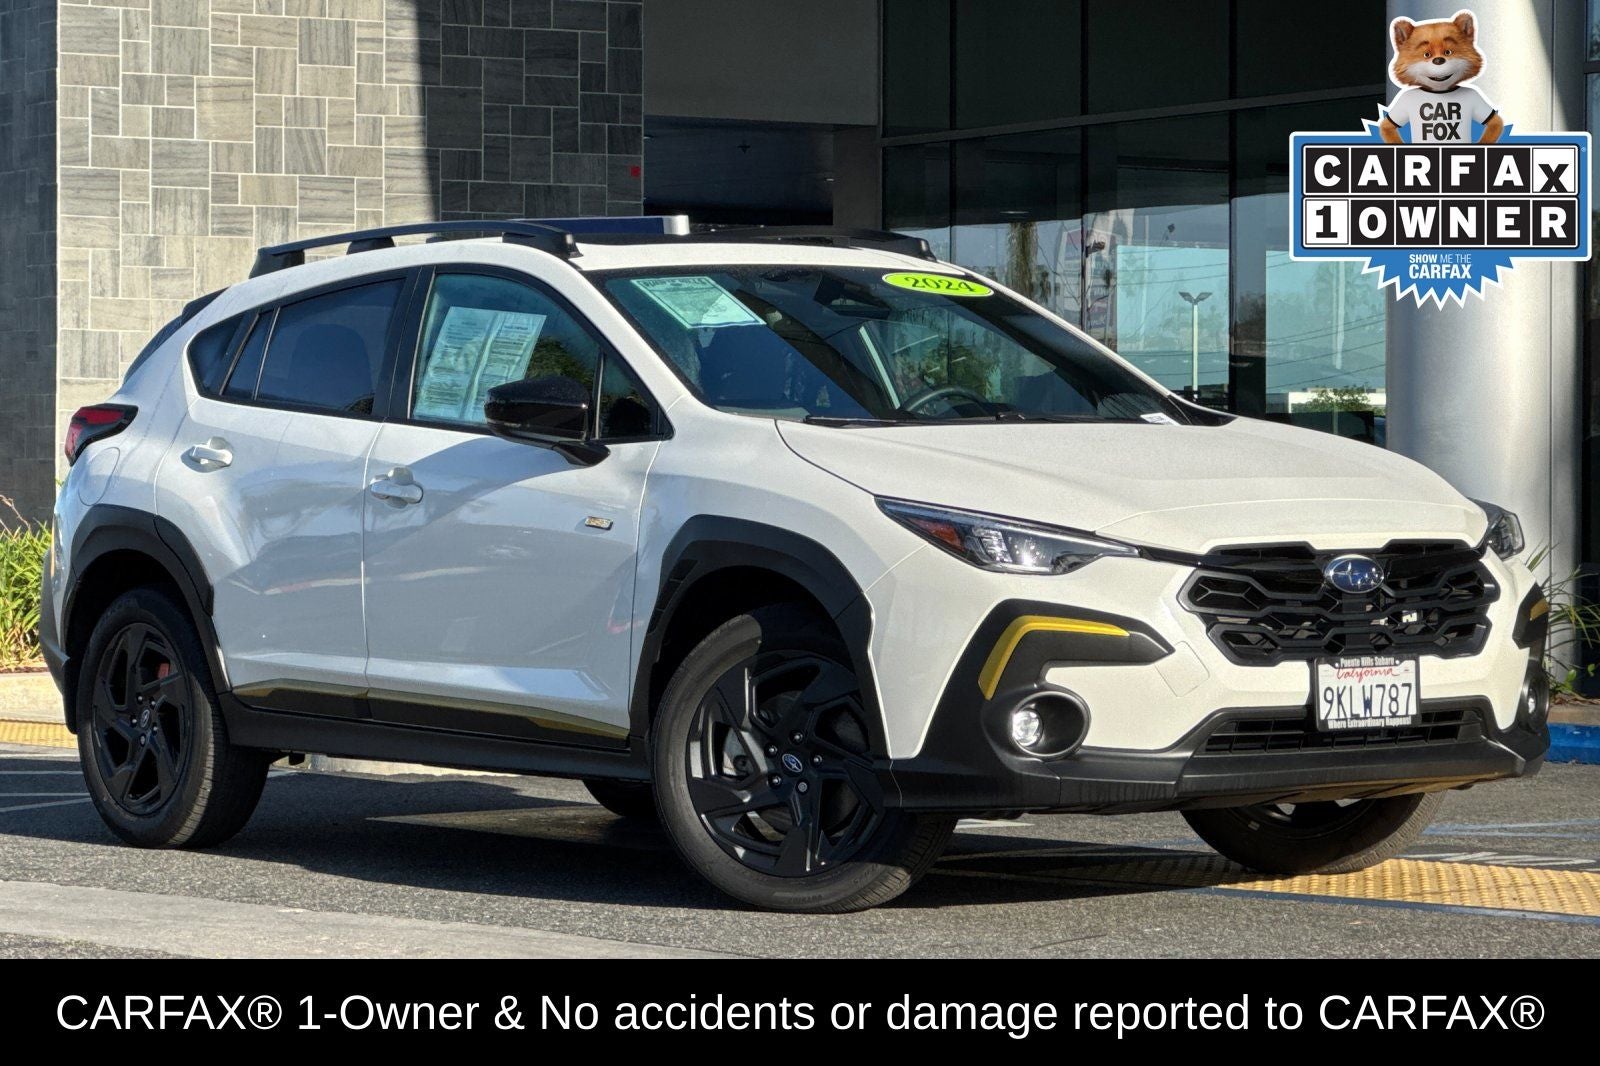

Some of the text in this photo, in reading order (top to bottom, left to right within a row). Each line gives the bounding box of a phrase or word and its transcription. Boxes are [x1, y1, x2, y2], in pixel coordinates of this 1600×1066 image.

[904, 276, 976, 292] 2024
[1375, 656, 1395, 667] Subaru
[1336, 666, 1401, 683] California
[1323, 683, 1413, 719] 9KLW787
